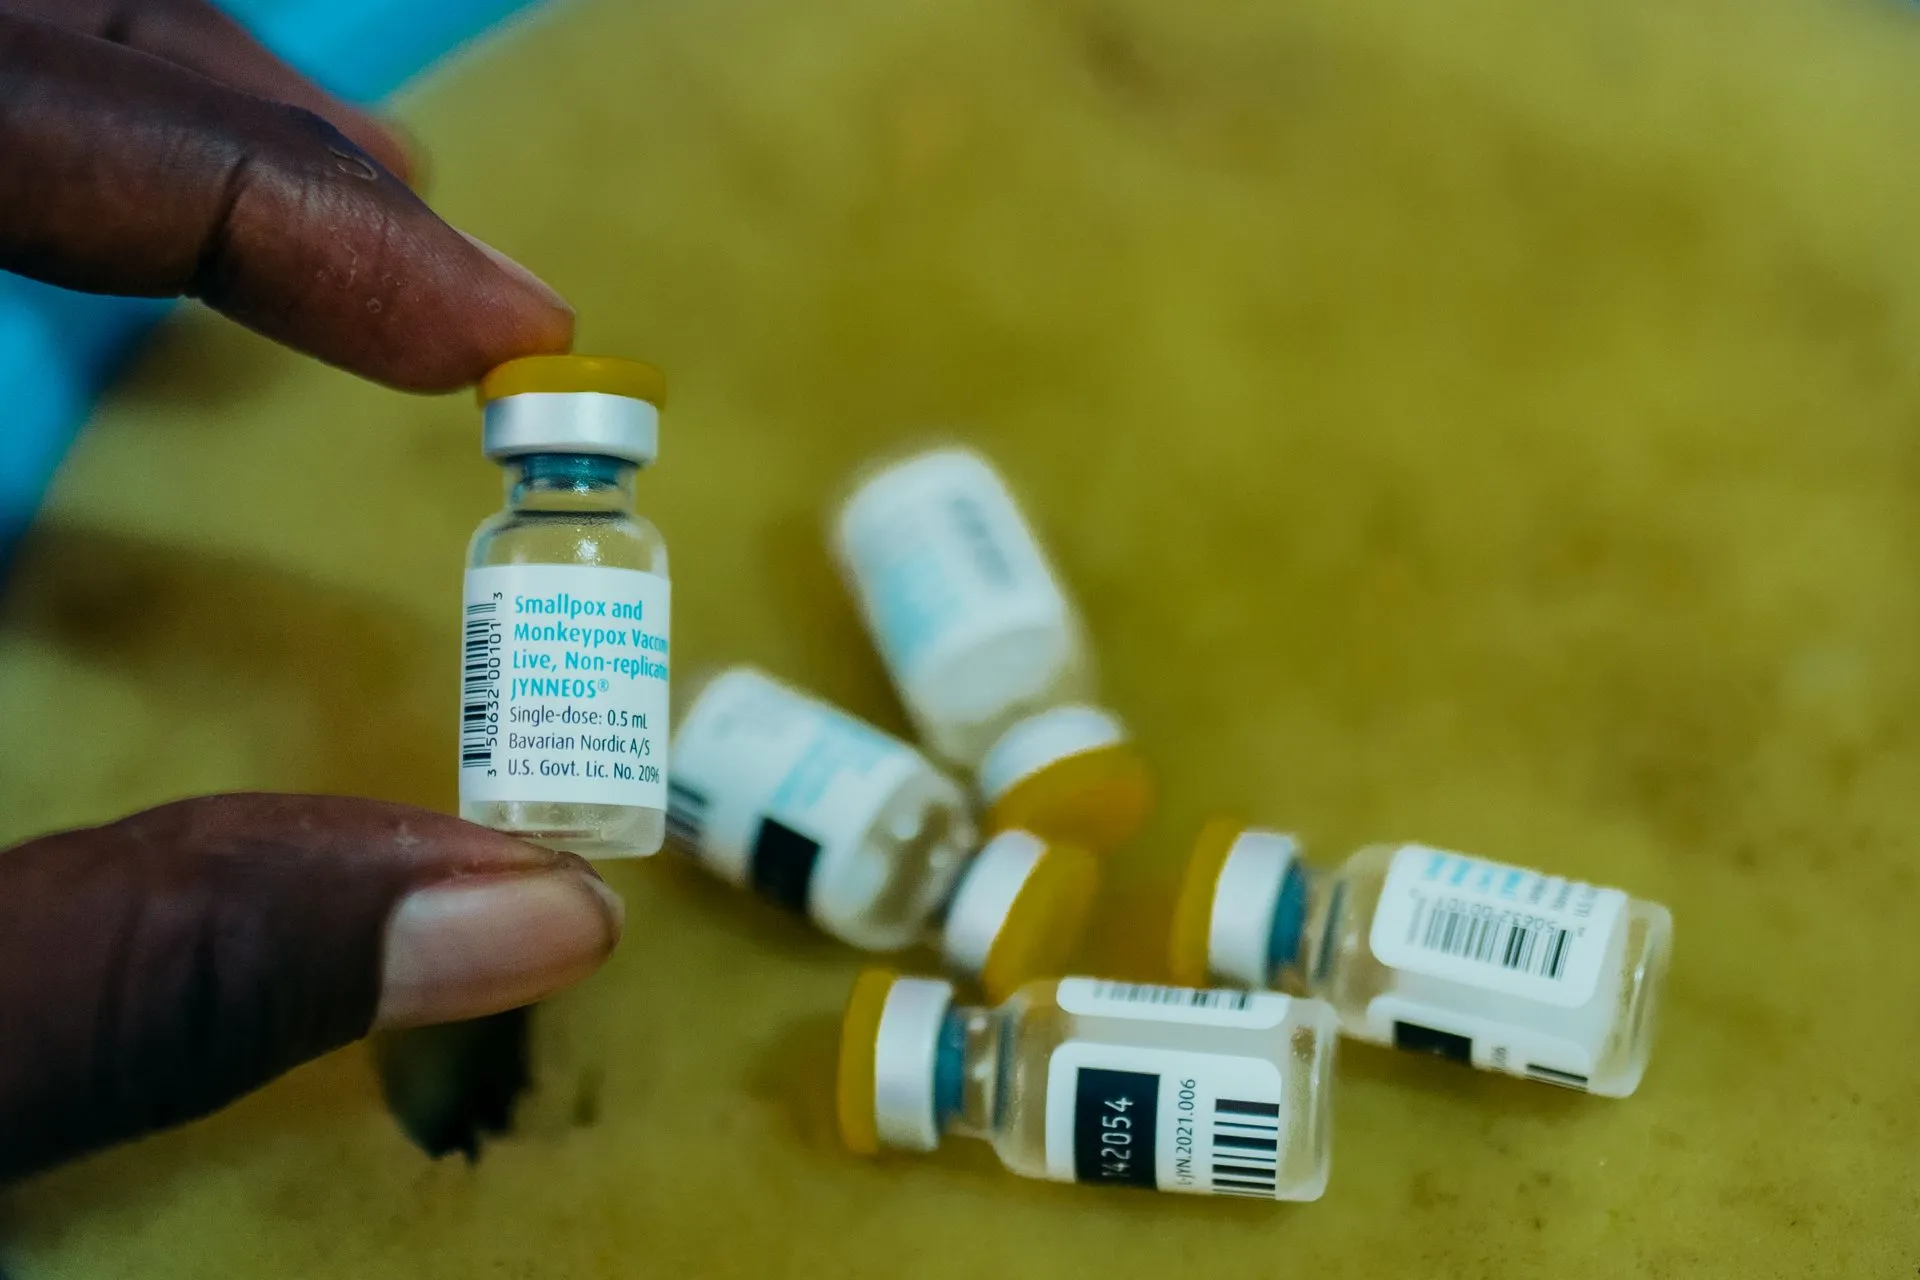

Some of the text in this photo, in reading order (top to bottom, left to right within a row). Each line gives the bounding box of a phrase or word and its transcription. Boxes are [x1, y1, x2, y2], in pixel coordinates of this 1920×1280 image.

[514, 593, 643, 621] Smallpox and
[513, 620, 627, 649] Monkeypox
[512, 648, 557, 673] Live,
[485, 591, 503, 778] 3 50632 00101 3
[509, 704, 603, 728] Single-dose:
[607, 709, 628, 728] 0.5
[508, 732, 651, 760] Bavarian Nordic A/S
[507, 758, 661, 785] U.S. Govt. Lic. No. 2096
